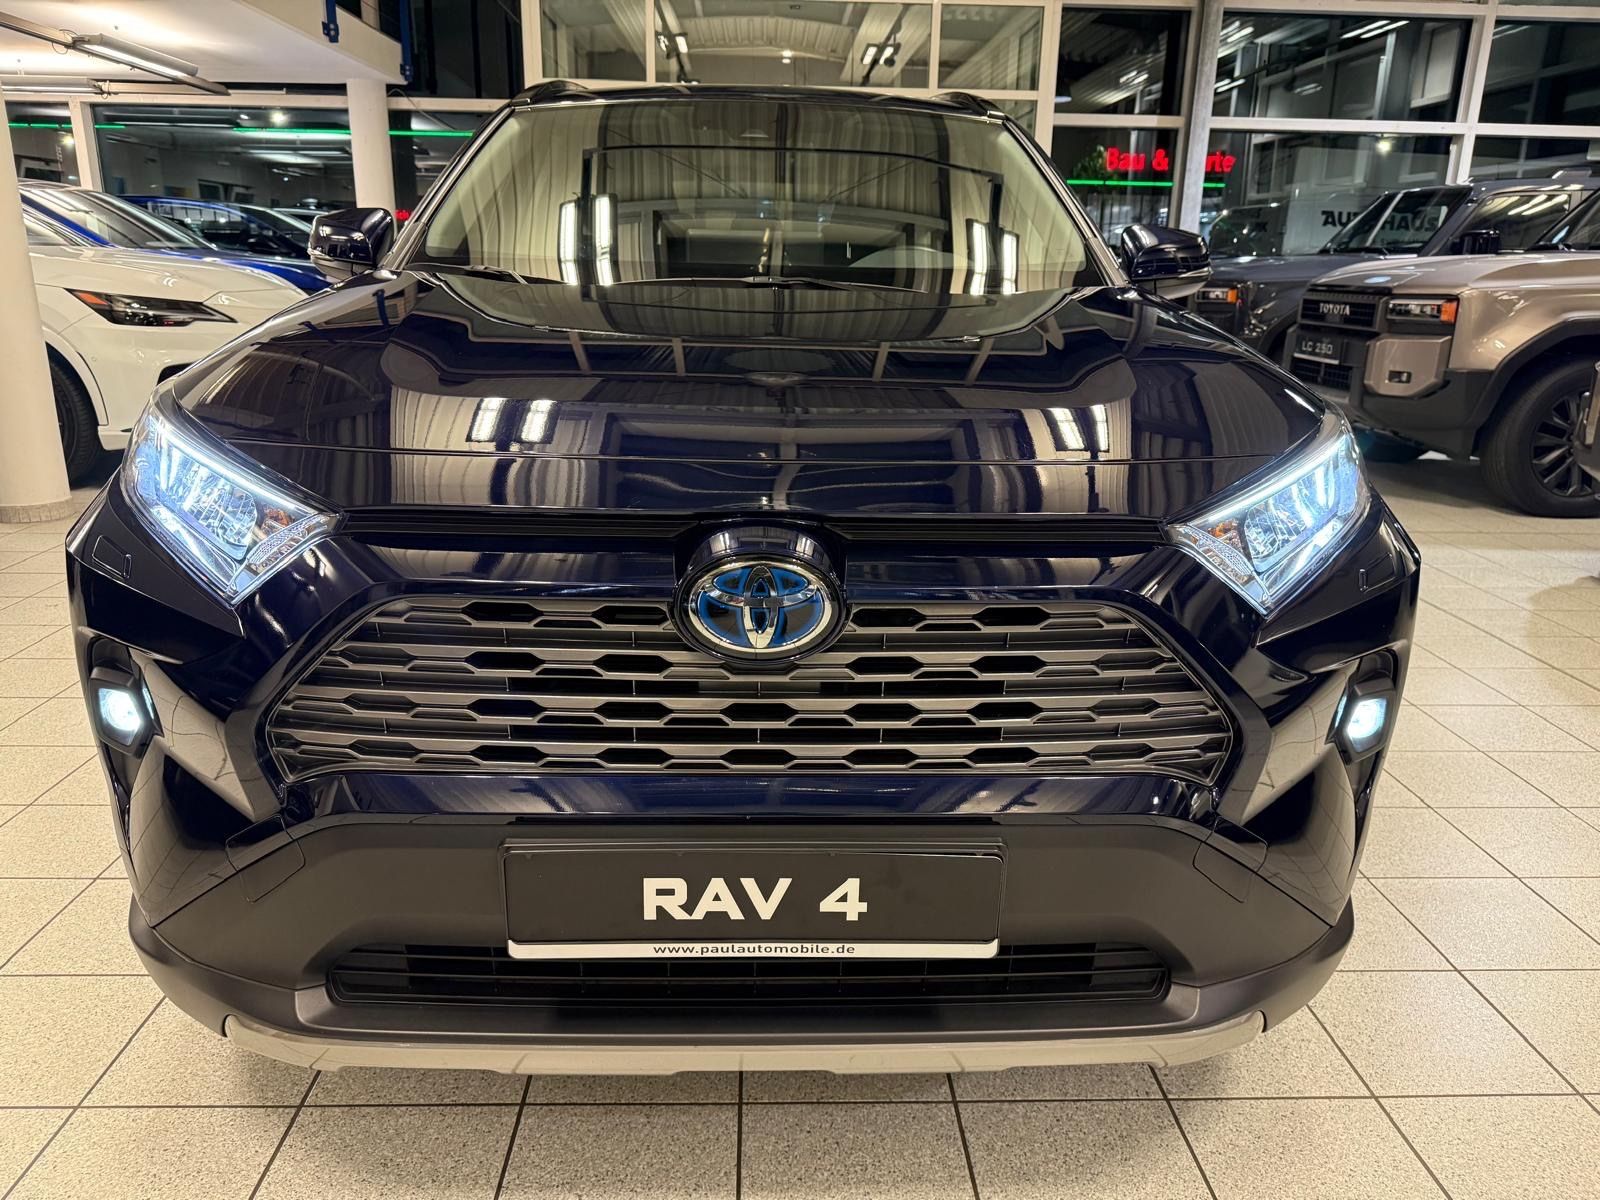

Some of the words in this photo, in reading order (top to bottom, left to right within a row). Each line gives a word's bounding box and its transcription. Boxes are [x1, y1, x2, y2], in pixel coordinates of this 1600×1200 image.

[1106, 148, 1145, 170] Bau
[1152, 149, 1169, 171] &
[1205, 151, 1236, 172] rte
[1319, 303, 1350, 316] TOYOTA
[1302, 341, 1314, 352] LC
[1315, 343, 1333, 355] 250
[643, 877, 793, 920] RAV
[819, 877, 868, 921] 4
[653, 944, 856, 955] www.paulautomobile.de
